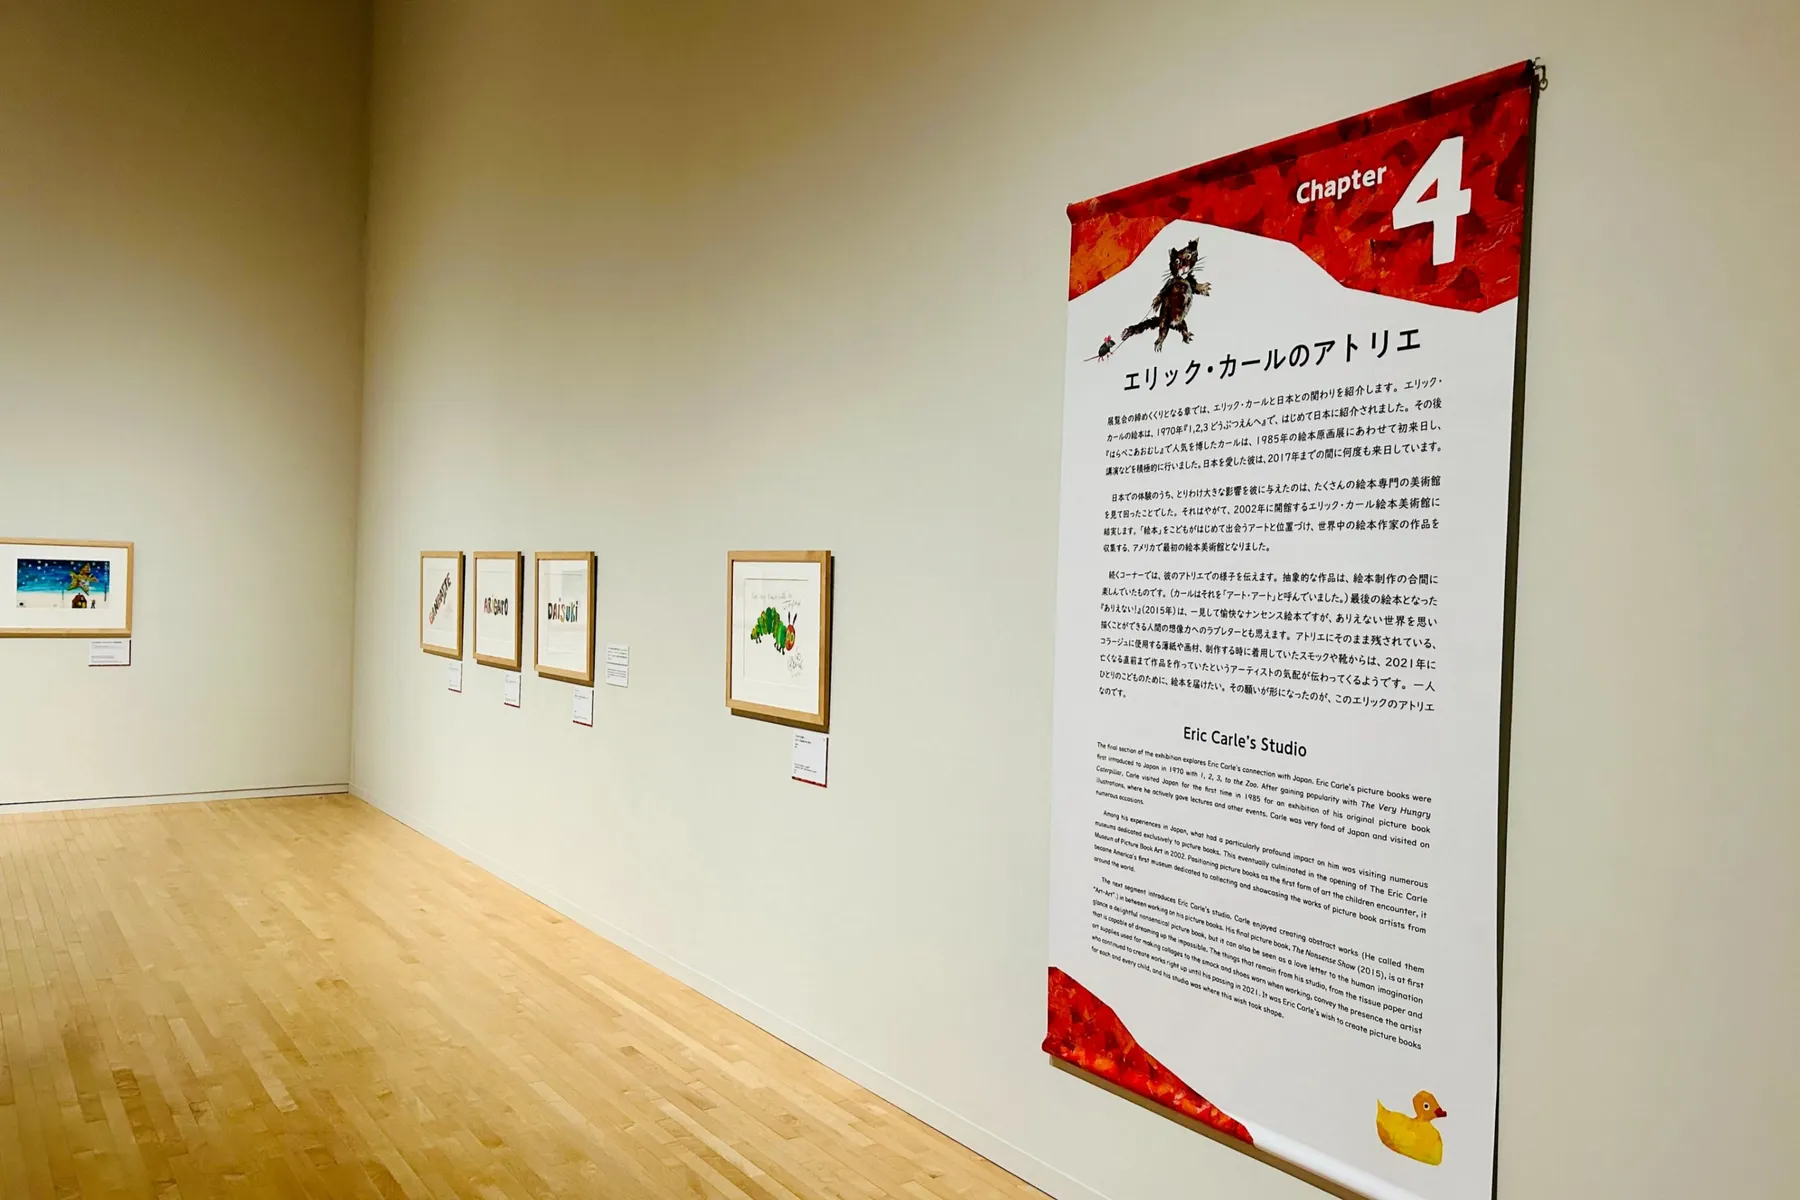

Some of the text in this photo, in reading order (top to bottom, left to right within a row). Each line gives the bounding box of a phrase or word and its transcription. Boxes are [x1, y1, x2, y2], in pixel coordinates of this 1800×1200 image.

[1296, 136, 1472, 266] Chapter 4
[1124, 329, 1421, 391] エリック・カールのアトリエ
[1183, 726, 1307, 757] Eric Carle's Studio
[1242, 767, 1276, 780] connection
[1292, 774, 1314, 784] Japan.
[1316, 778, 1329, 787] Eric
[1330, 780, 1355, 792] Carle's
[1356, 786, 1384, 797] picture
[1386, 789, 1410, 800] books
[1412, 795, 1432, 804] were
[1261, 783, 1431, 821] After gaining popularity with The Very Hungry
[1264, 796, 1274, 805] for
[1288, 803, 1320, 814] exhibition
[1333, 810, 1343, 819] his
[1346, 813, 1375, 825] original
[1378, 817, 1407, 830] picture
[1411, 823, 1431, 834] book
[1269, 811, 1287, 822] Carle
[1289, 817, 1302, 825] was
[1304, 820, 1319, 829] very
[1320, 821, 1335, 832] fond
[1347, 827, 1370, 838] Japan
[1372, 832, 1388, 842] and
[1390, 835, 1417, 847] visited
[1420, 841, 1430, 849] on
[1262, 847, 1291, 859] profound
[1293, 852, 1315, 864] impact
[1327, 861, 1340, 870] him
[1342, 866, 1356, 874] was
[1358, 868, 1387, 882] visiting
[1389, 876, 1428, 889] numerous
[1271, 863, 1428, 904] culminated in the opening of The Eric Carle
[1252, 885, 1426, 934] showcasing the works of picture book artists from
[1270, 876, 1280, 884] the
[1281, 878, 1295, 888] first
[1297, 881, 1312, 892] form
[1312, 886, 1320, 894] of
[1321, 889, 1331, 897] art
[1332, 891, 1344, 901] the
[1345, 894, 1375, 908] children
[1376, 903, 1419, 918] encounter,
[1421, 910, 1427, 919] it
[1273, 939, 1291, 952] book,
[1292, 944, 1305, 955] The
[1305, 949, 1336, 965] Nonsense
[1337, 959, 1356, 971] Show
[1357, 964, 1387, 980] (2015),
[1388, 972, 1396, 982] is
[1407, 978, 1424, 989] first
[1279, 929, 1425, 974] creating abstract works (He called them
[1190, 982, 1202, 990] was
[1203, 986, 1220, 996] where
[1221, 991, 1232, 1001] this
[1233, 997, 1247, 1006] wish
[1248, 1001, 1262, 1011] took
[1255, 963, 1423, 1020] remain from his studio, from the tissue paper and
[1262, 951, 1424, 1004] seen as a love letter to the human imagination
[1262, 991, 1422, 1050] It was Eric Carle's wish to create picture books
[1267, 980, 1422, 1035] when working, convey the presence the artist
